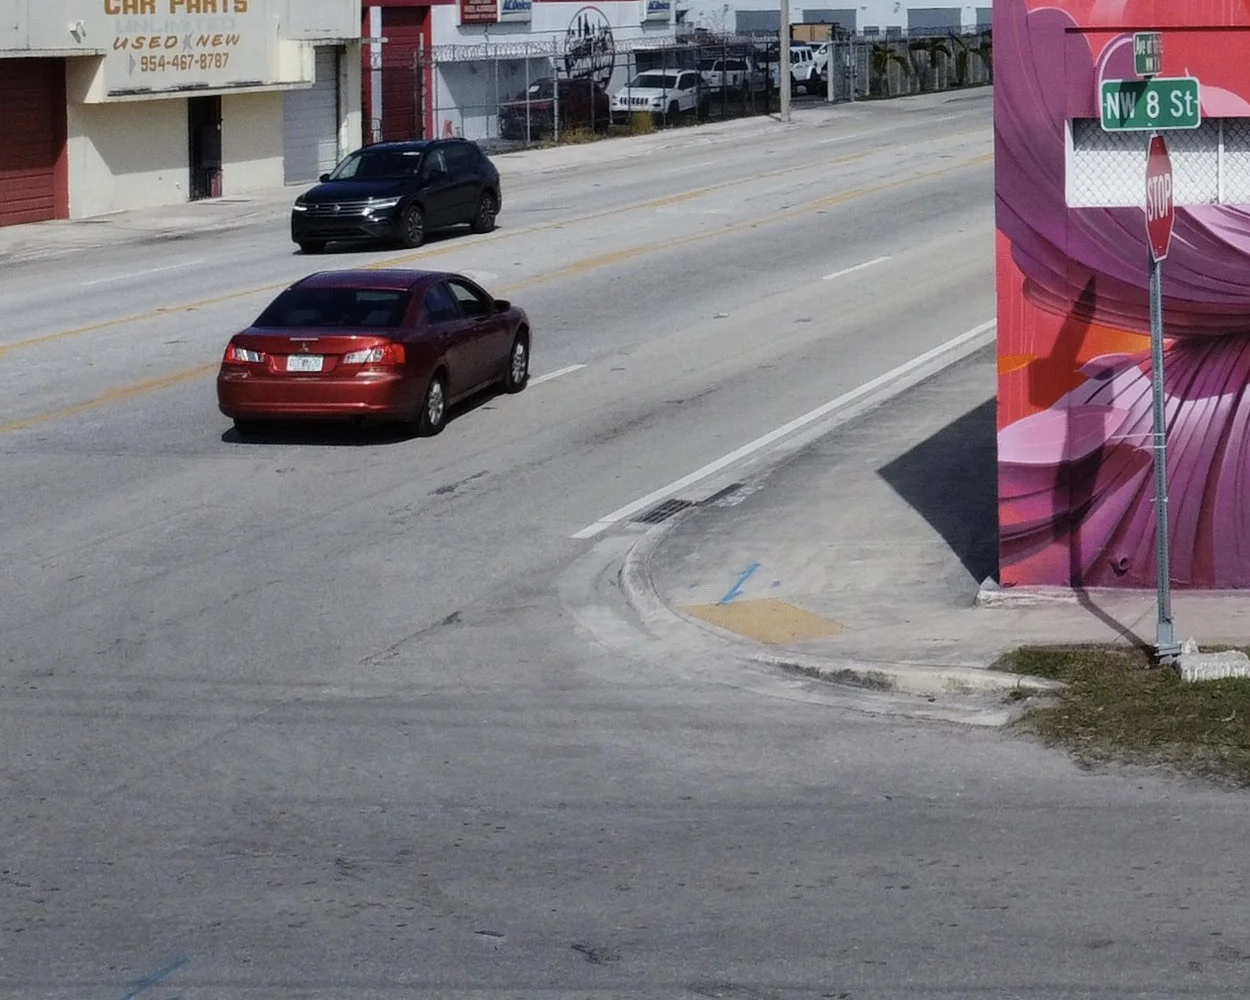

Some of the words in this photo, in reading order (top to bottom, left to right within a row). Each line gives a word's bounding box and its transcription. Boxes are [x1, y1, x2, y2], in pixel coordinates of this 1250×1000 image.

[113, 35, 178, 50] USED
[196, 33, 240, 47] NEW
[140, 52, 230, 72] 954-467-8787
[1106, 92, 1136, 119] NW
[1146, 90, 1160, 119] 8
[1170, 90, 1194, 118] St
[1147, 173, 1171, 222] STOP
